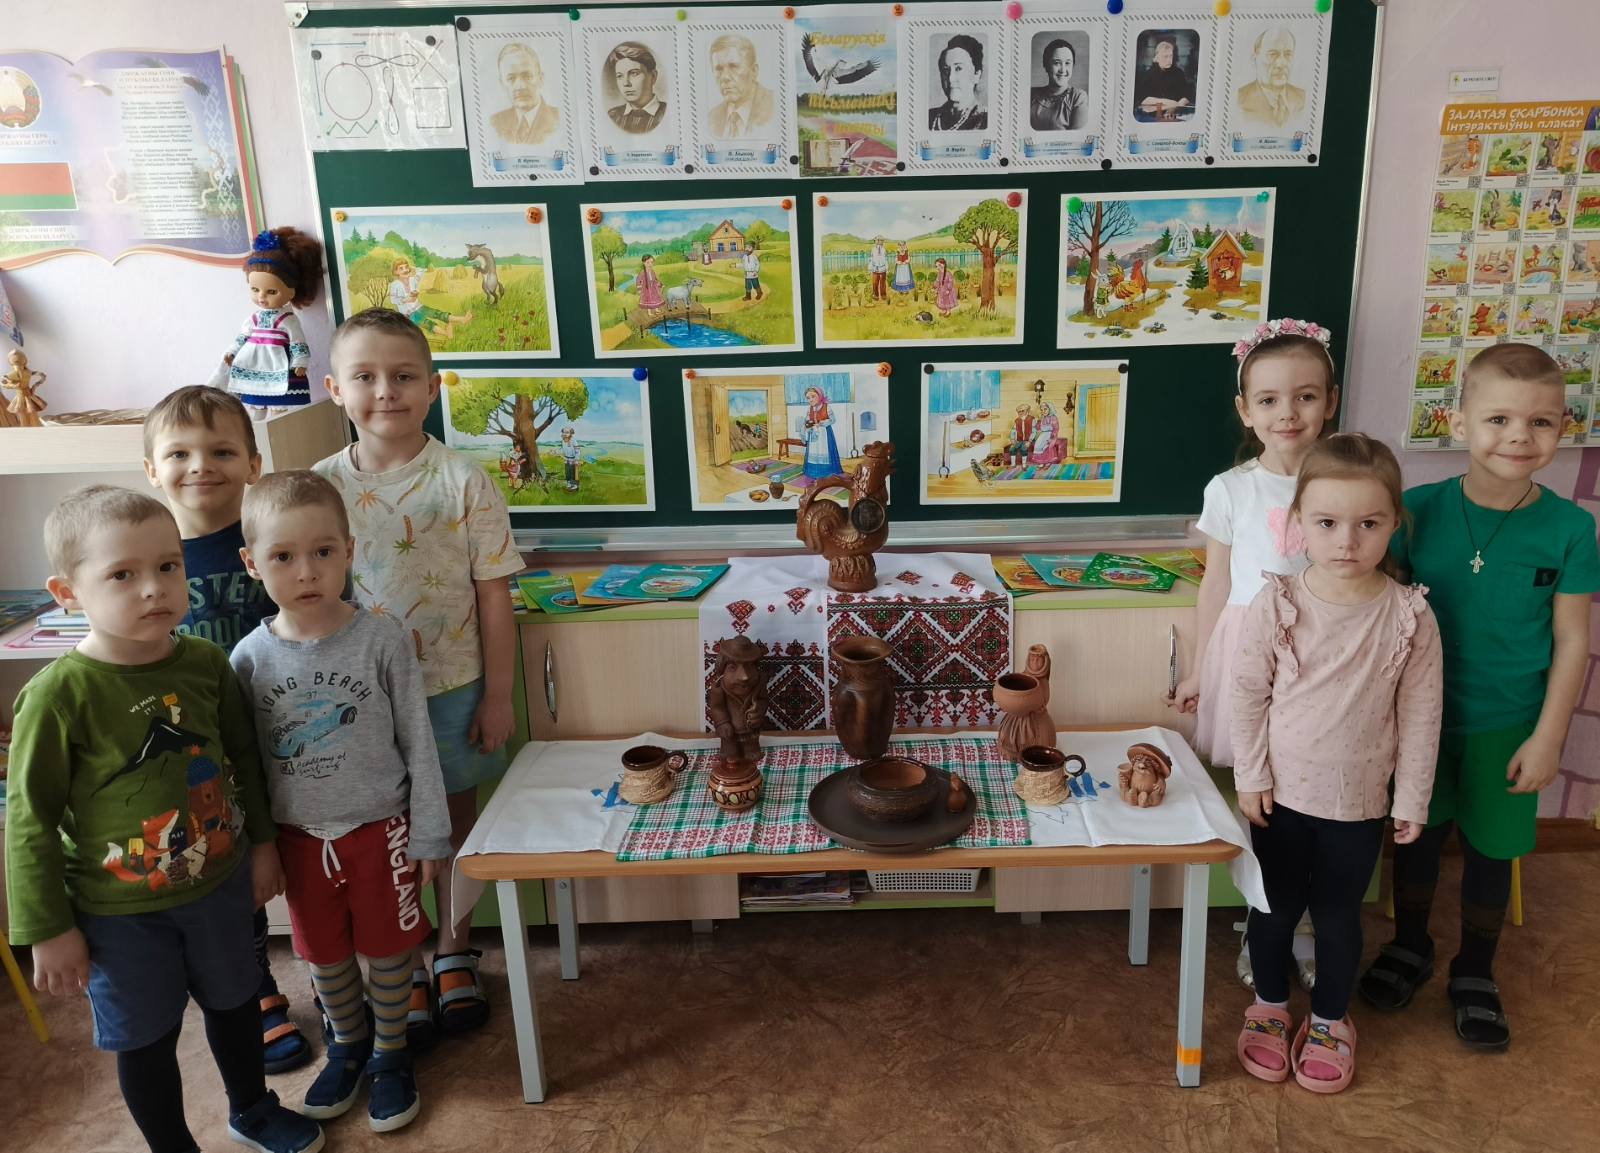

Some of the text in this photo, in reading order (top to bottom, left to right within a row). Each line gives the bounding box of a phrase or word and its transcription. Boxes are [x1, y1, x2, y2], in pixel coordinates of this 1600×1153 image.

[1446, 119, 1583, 132] Інтэрактыўны плакат
[1448, 106, 1585, 121] ЗАЛАТАЯ СКАРБОНКА
[258, 671, 373, 714] LONG BEACH
[386, 814, 420, 931] ENGLAND
